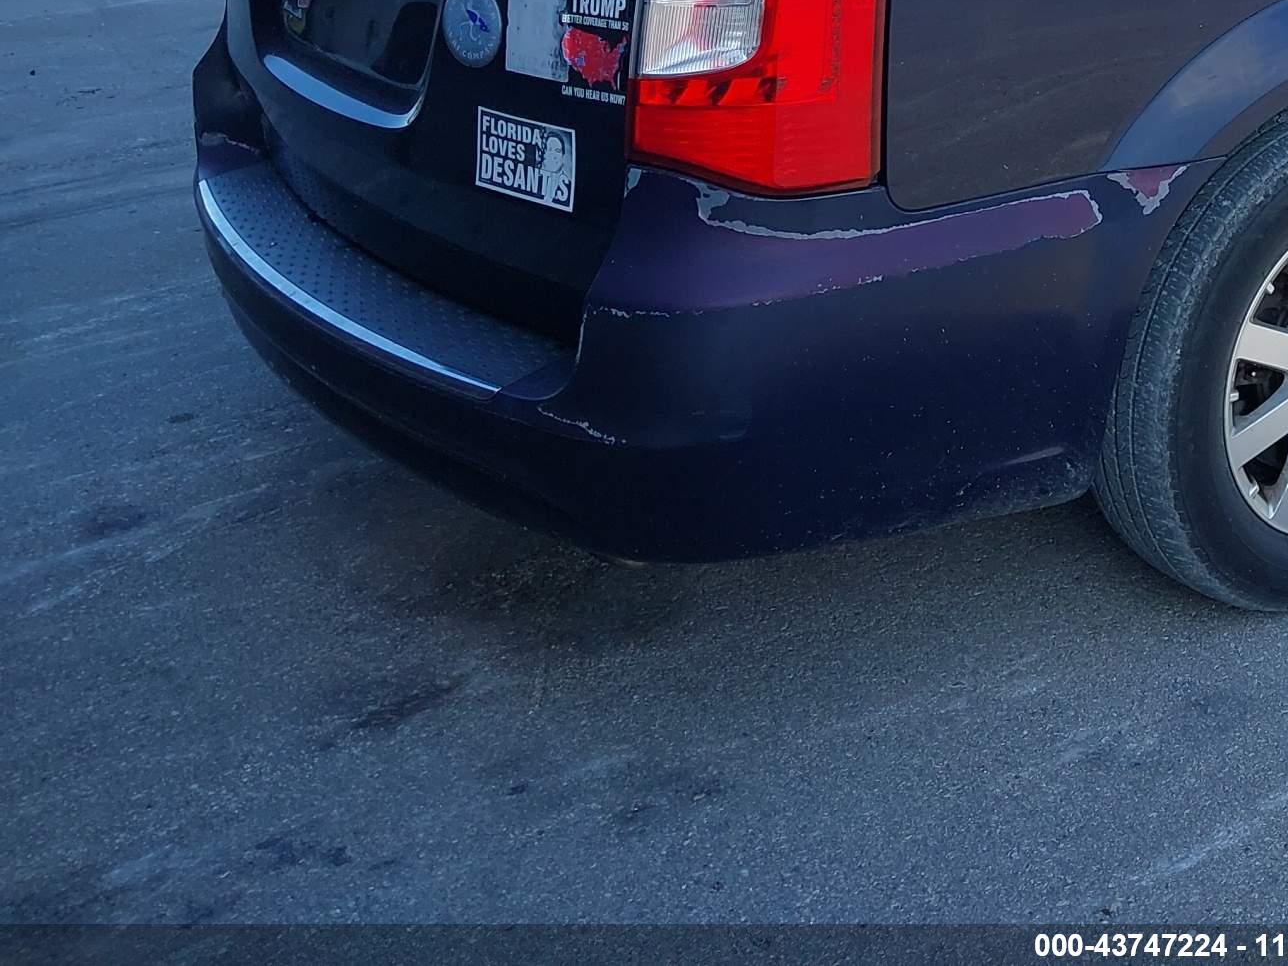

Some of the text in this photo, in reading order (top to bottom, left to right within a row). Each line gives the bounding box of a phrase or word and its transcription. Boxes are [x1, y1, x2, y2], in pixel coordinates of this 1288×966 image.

[562, 13, 583, 25] BETTER
[583, 16, 607, 28] COVERAGE
[608, 19, 621, 31] THAN
[561, 84, 627, 106] CAN YOU HEAR US NOW?
[482, 115, 542, 149] FLORIDA
[482, 134, 526, 162] LOVES
[481, 153, 570, 202] DESANTS
